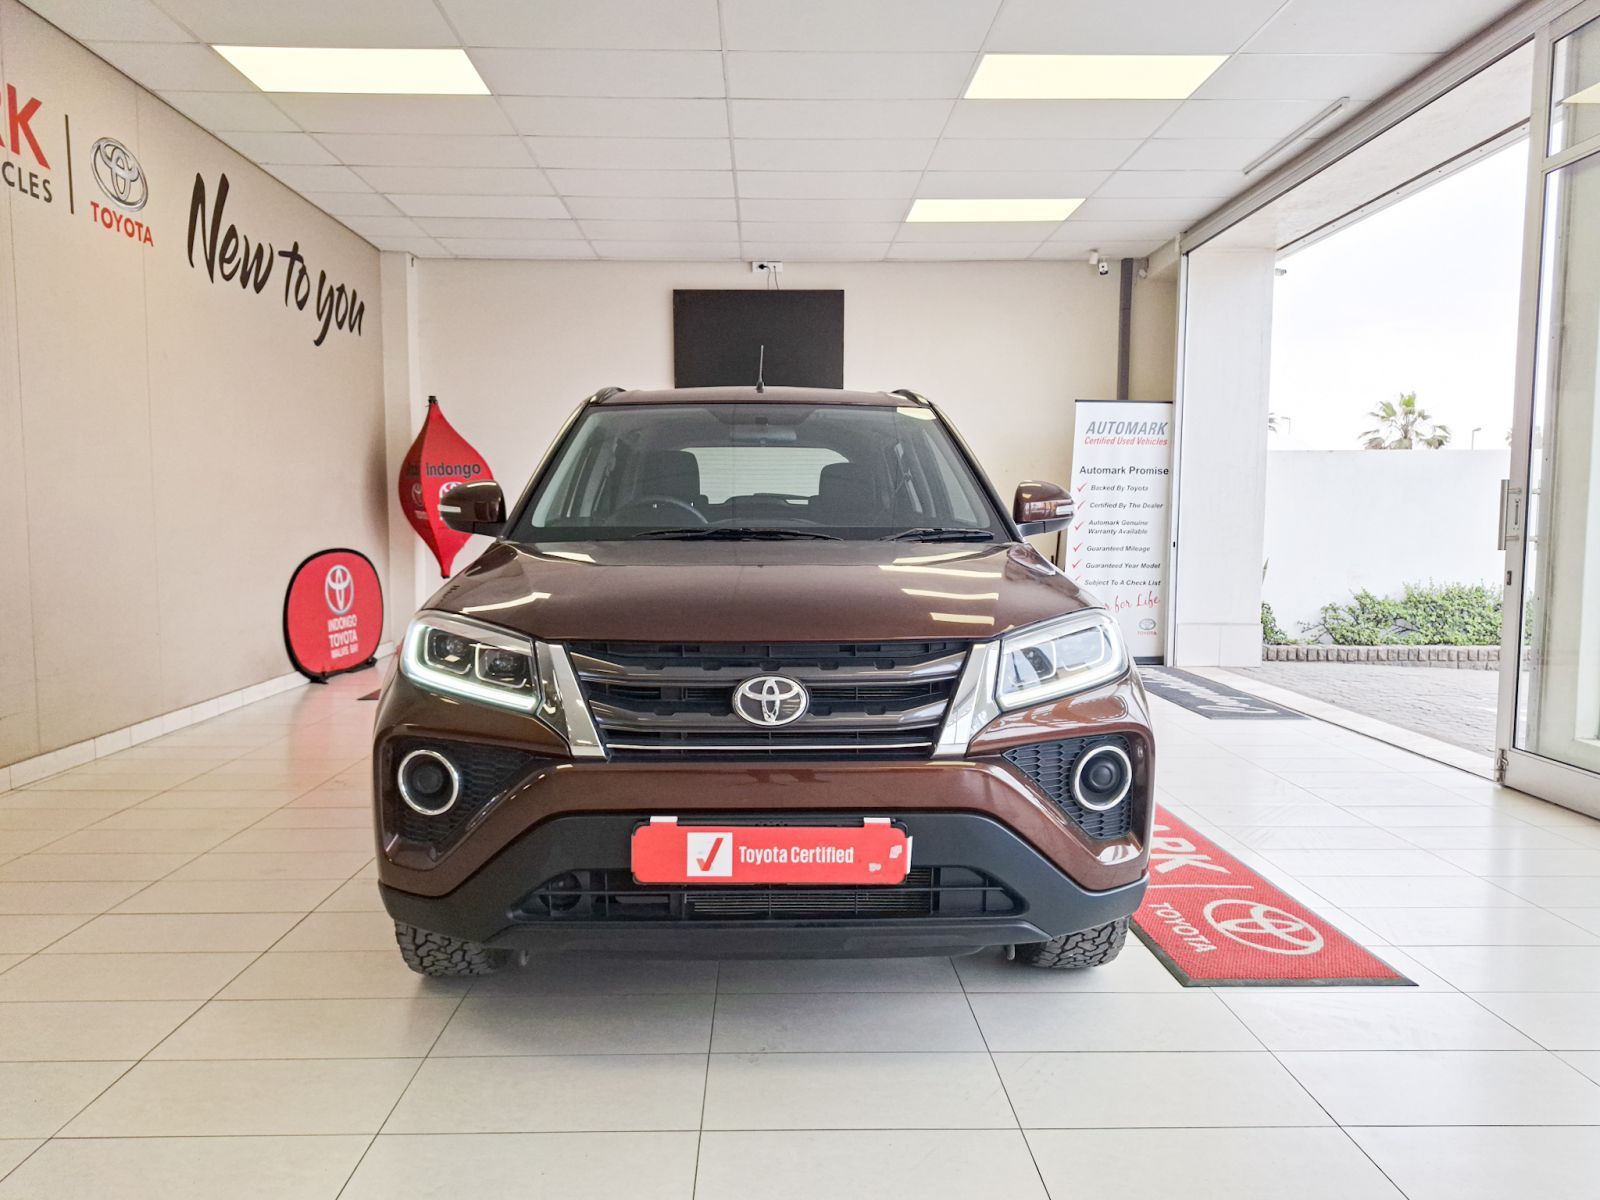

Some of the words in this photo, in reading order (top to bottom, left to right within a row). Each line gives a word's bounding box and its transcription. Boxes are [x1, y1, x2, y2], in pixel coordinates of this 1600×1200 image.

[90, 201, 153, 247] TOYOTA
[187, 172, 274, 294] New
[278, 241, 310, 311] to
[313, 270, 365, 347] you
[1086, 421, 1168, 435] AUTOMARK
[1084, 436, 1115, 445] Certified
[1117, 437, 1135, 445] Used
[1137, 437, 1168, 446] Vehicles
[426, 463, 481, 478] Indongo
[1080, 466, 1125, 475] Automark
[1129, 466, 1169, 475] Promise
[1114, 595, 1131, 613] for
[1137, 590, 1160, 609] Life
[328, 629, 358, 648] TOYOTA
[739, 846, 788, 865] Toyota
[790, 846, 854, 864] Certified
[1148, 902, 1217, 953] TOYOTA
